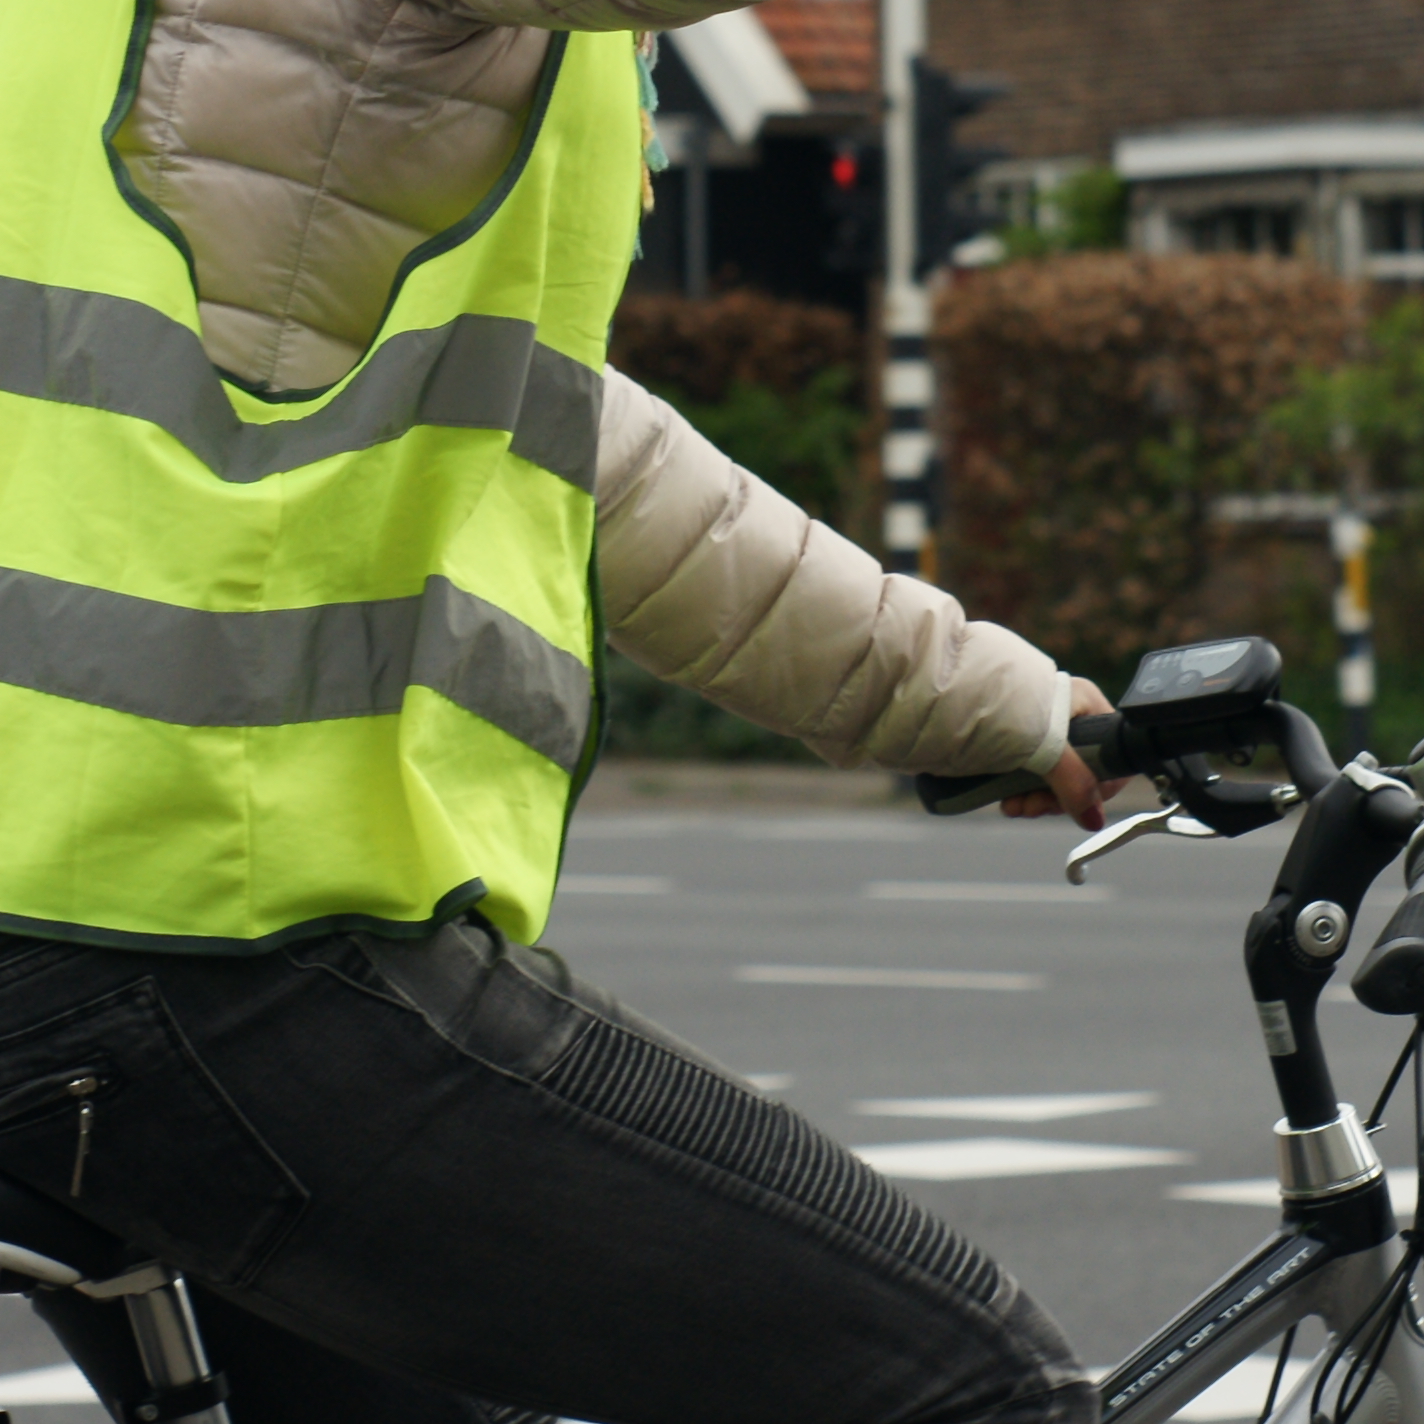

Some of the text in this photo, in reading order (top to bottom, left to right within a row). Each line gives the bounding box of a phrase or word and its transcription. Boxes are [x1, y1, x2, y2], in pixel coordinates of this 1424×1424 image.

[1108, 1245, 1311, 1408] STATE OF THE ART
